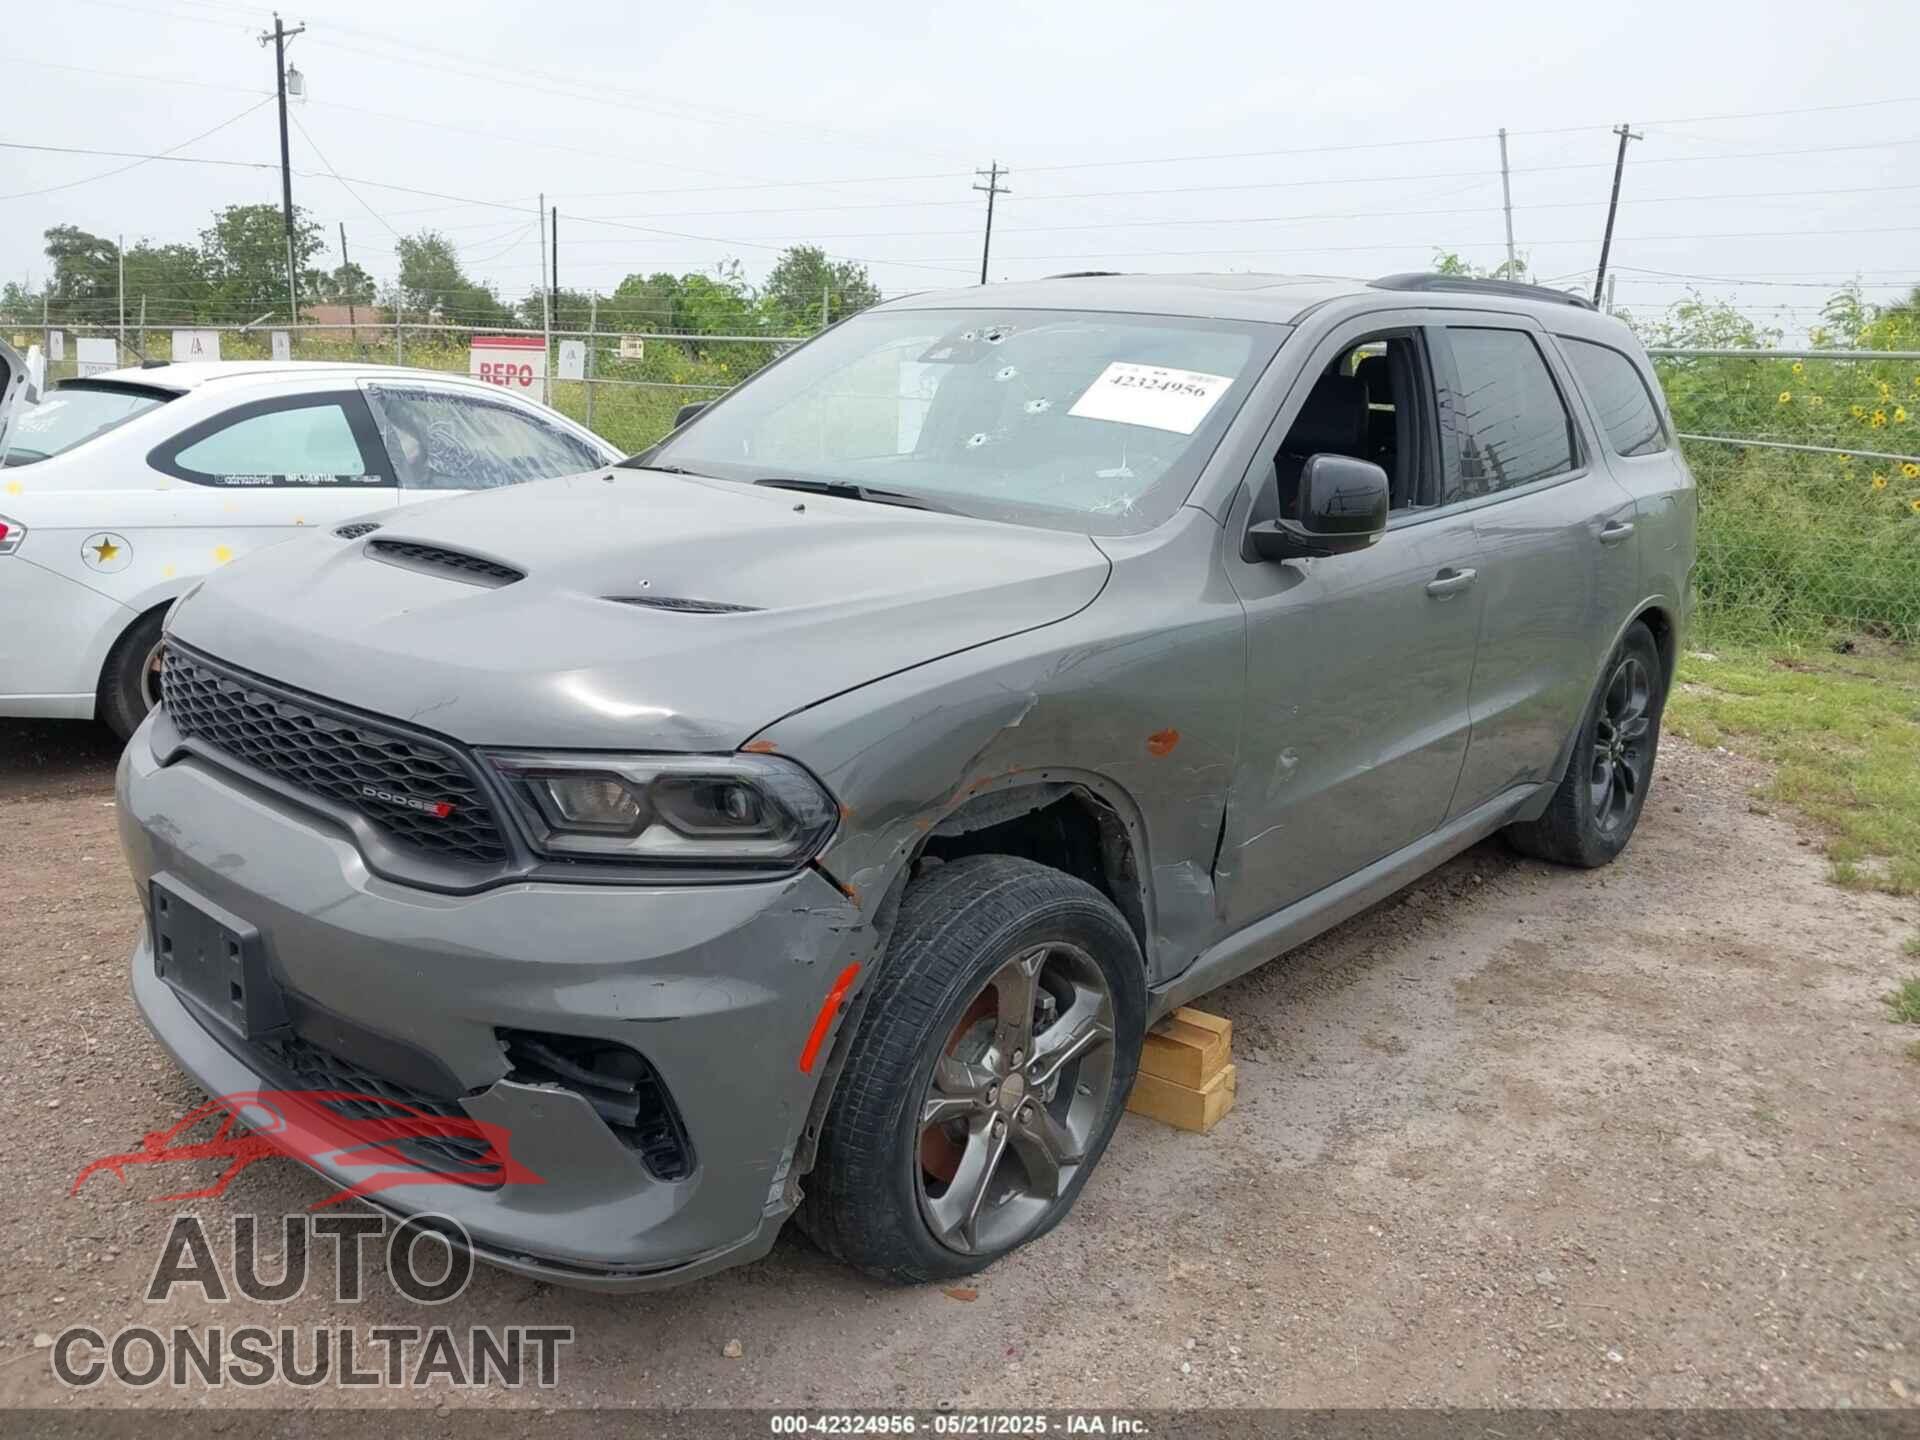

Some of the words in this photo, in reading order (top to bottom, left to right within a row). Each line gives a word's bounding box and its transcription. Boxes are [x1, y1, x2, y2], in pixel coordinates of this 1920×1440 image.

[480, 362, 533, 387] REPO
[1109, 374, 1206, 397] 42324956
[362, 786, 438, 814] DODGE
